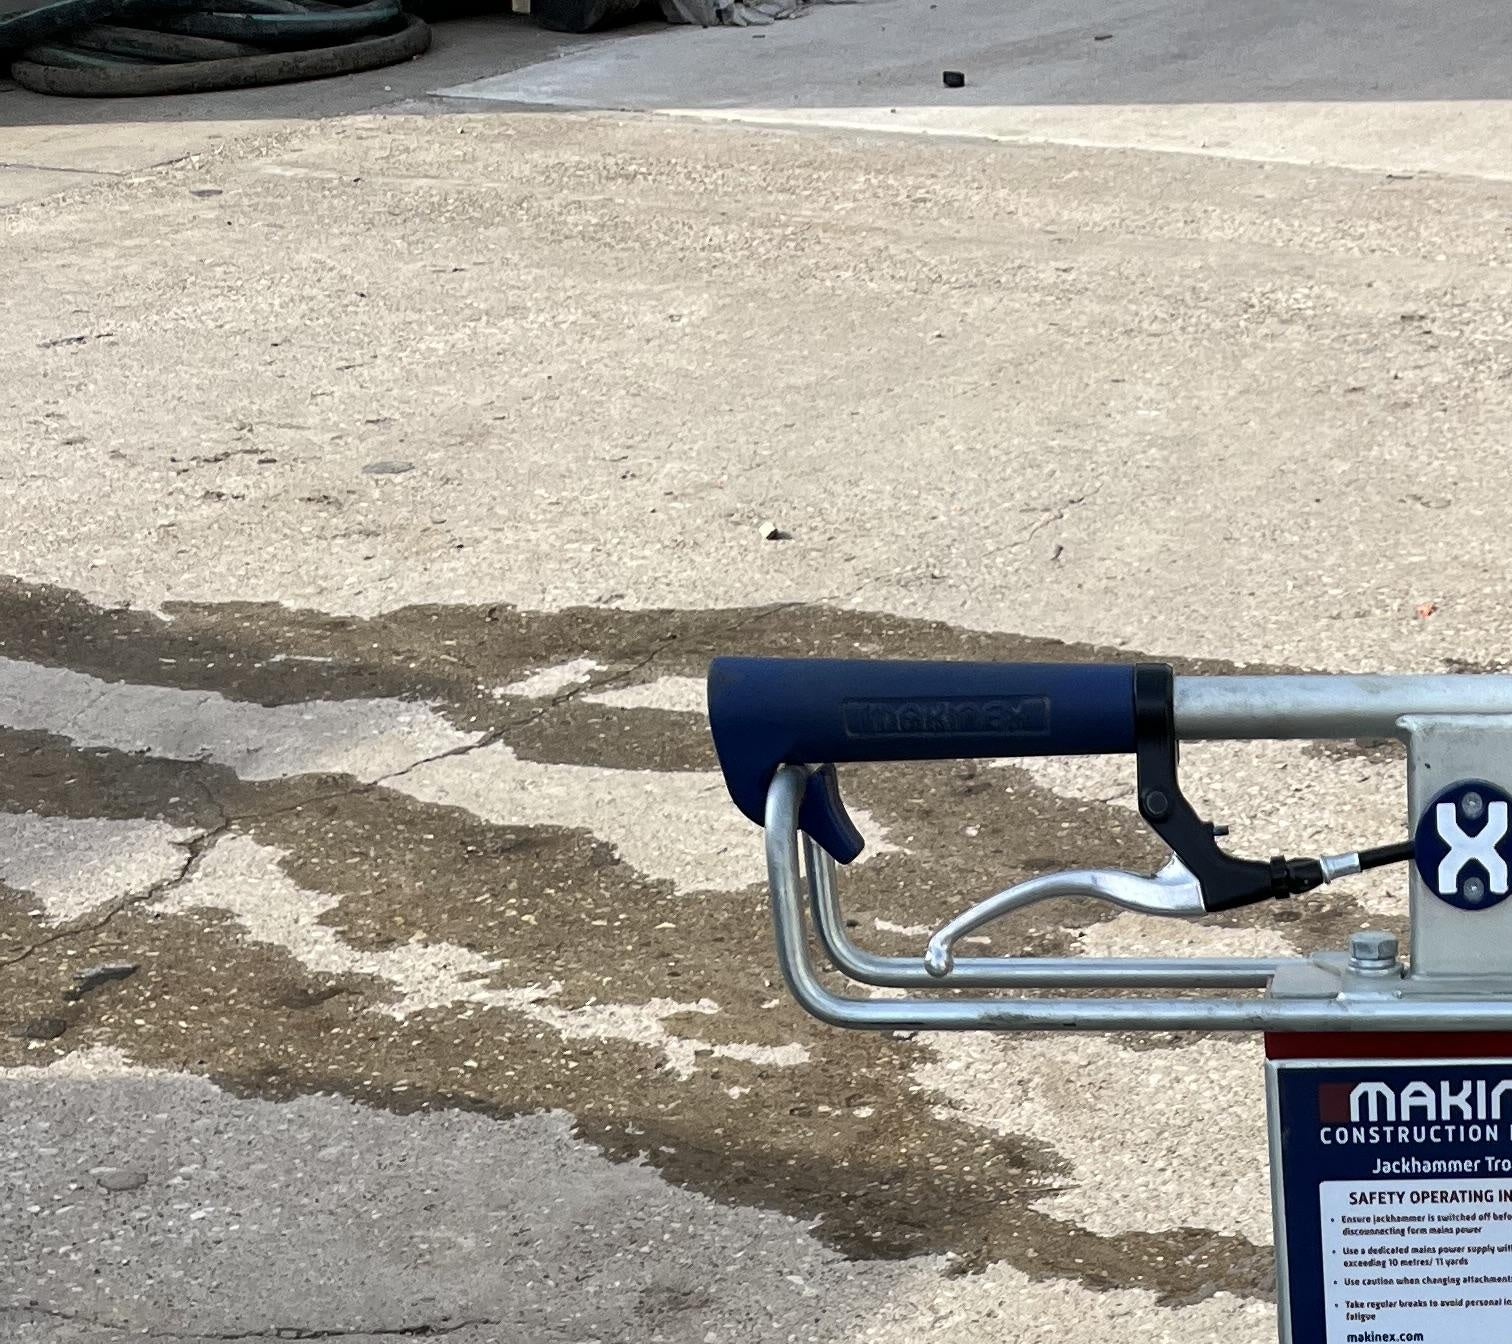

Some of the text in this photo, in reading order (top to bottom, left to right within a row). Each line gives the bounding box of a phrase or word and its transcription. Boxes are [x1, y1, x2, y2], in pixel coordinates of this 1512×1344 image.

[1320, 1124, 1499, 1145] CONSTRUCTION
[1372, 1156, 1480, 1175] Jackhammer
[1349, 1191, 1406, 1206] SAFETY
[1410, 1189, 1494, 1204] OPERATING
[1341, 1214, 1371, 1223] Ensure
[1373, 1214, 1426, 1225] jackhammer
[1428, 1213, 1435, 1222] is
[1437, 1212, 1476, 1222] switched
[1478, 1212, 1491, 1221] off
[1429, 1225, 1454, 1235] mains
[1455, 1226, 1482, 1236] power
[1342, 1246, 1359, 1255] Use
[1367, 1245, 1410, 1255] dedicated
[1411, 1245, 1436, 1254] mains
[1438, 1246, 1465, 1256] power
[1467, 1243, 1495, 1255] supply
[1343, 1257, 1387, 1269] exceeding
[1388, 1258, 1398, 1267] 10
[1445, 1256, 1469, 1268] yards
[1344, 1277, 1360, 1286] Use
[1362, 1276, 1395, 1286] caution
[1396, 1276, 1420, 1286] when
[1421, 1275, 1461, 1287] changing
[1345, 1300, 1365, 1309] Take
[1366, 1299, 1397, 1310] regular
[1399, 1299, 1428, 1308] breaks
[1429, 1299, 1438, 1308] to
[1440, 1298, 1464, 1307] avoid
[1465, 1297, 1502, 1308] personal
[1345, 1311, 1376, 1322] fatigue
[1346, 1330, 1424, 1343] makinex.com
